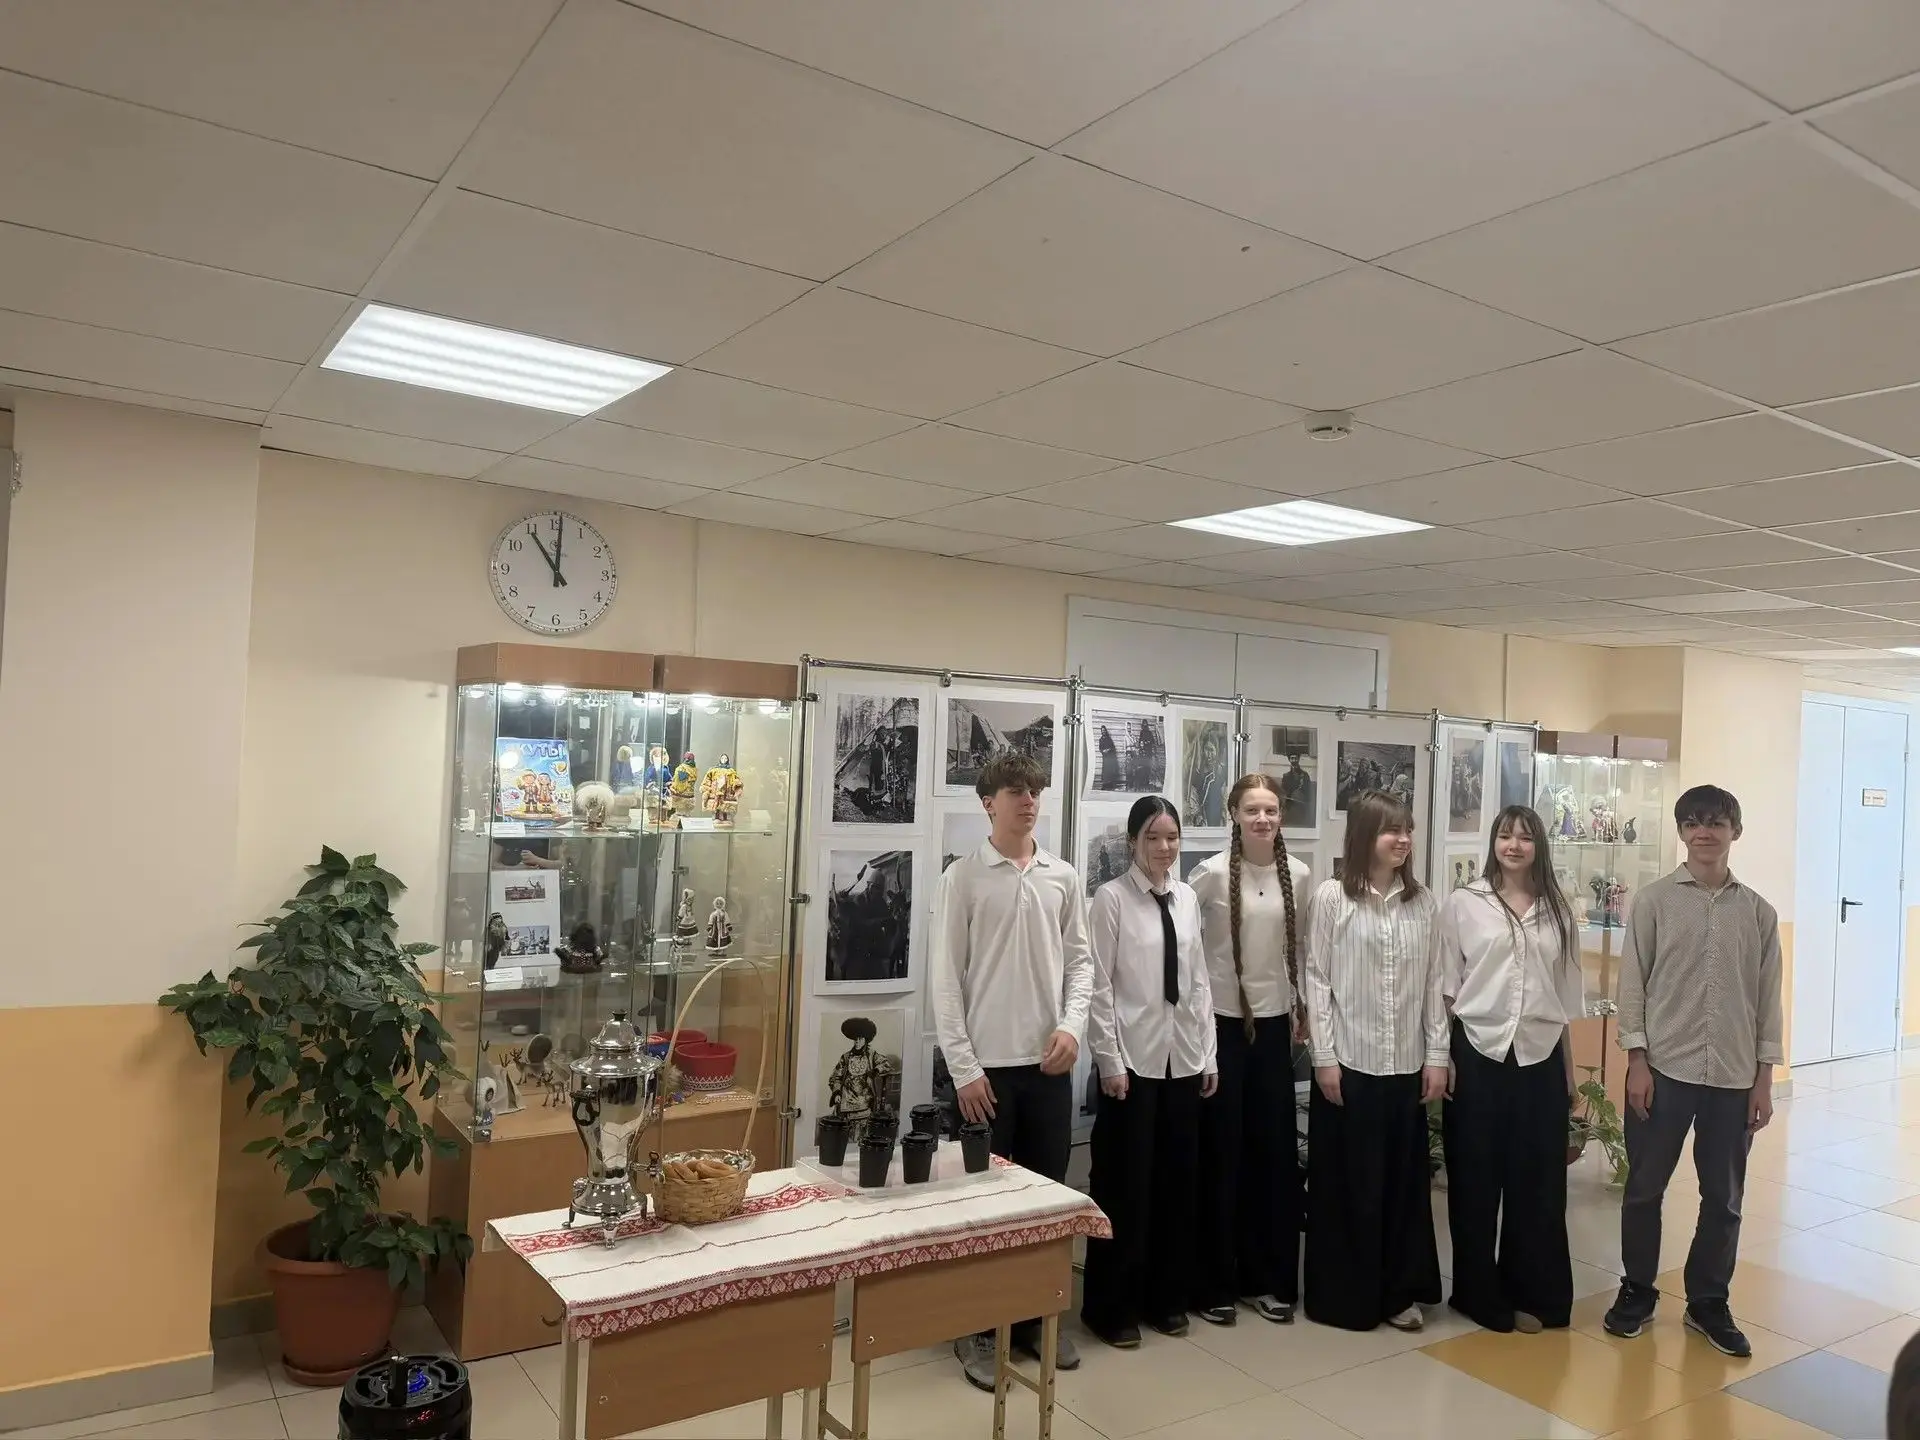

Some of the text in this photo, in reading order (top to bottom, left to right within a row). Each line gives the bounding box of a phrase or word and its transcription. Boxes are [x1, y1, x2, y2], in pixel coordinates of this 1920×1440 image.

[526, 523, 537, 535] 11
[579, 527, 583, 539] 1
[508, 539, 522, 551] 10
[593, 546, 601, 558] 2
[501, 563, 510, 575] 9
[601, 570, 609, 582] 3
[508, 585, 518, 598] 8
[593, 591, 602, 603] 4
[527, 605, 536, 618] 7
[579, 609, 588, 620] 5
[551, 614, 561, 625] 6
[513, 742, 565, 759] УТЫ
